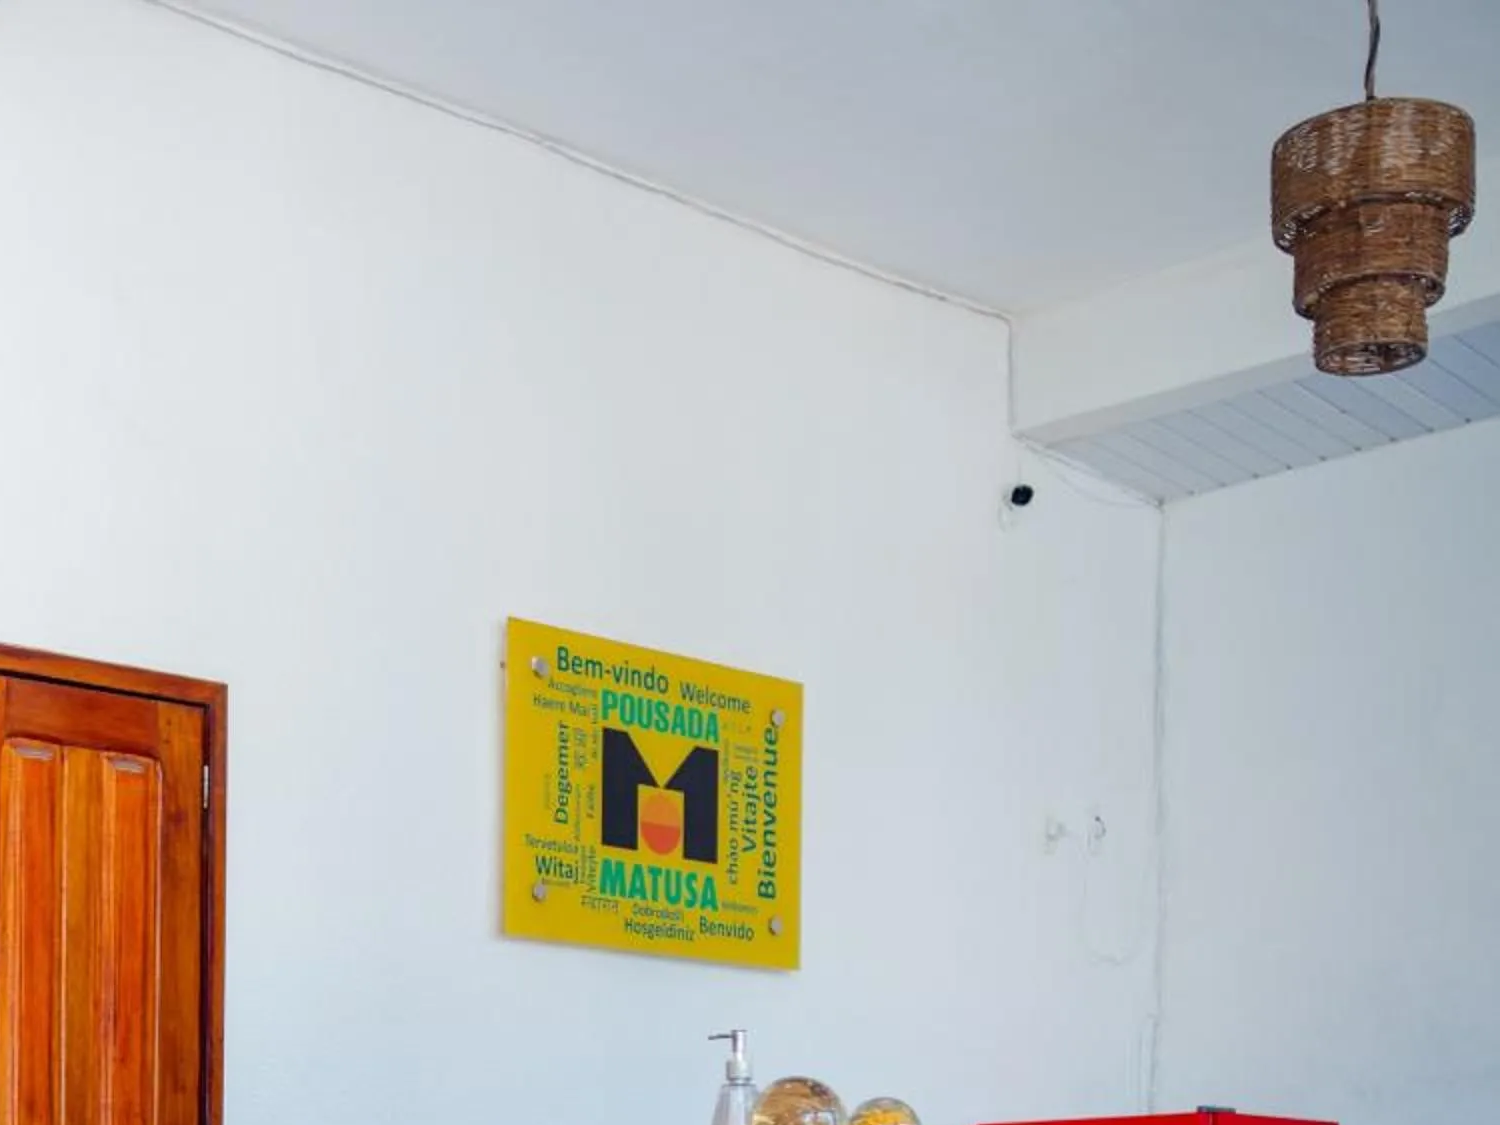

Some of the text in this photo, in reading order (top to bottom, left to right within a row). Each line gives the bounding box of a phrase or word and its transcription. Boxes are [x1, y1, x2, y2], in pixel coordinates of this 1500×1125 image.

[557, 646, 669, 693] Bem-vindo
[601, 688, 719, 743] POUSADA
[680, 682, 751, 714] Welcome
[555, 721, 573, 825] Degemer
[742, 766, 760, 852] Vitajte
[758, 727, 778, 900] Bienvenue
[535, 856, 579, 884] Witaj
[601, 858, 719, 912] MATUSA
[699, 915, 754, 941] Benvido
